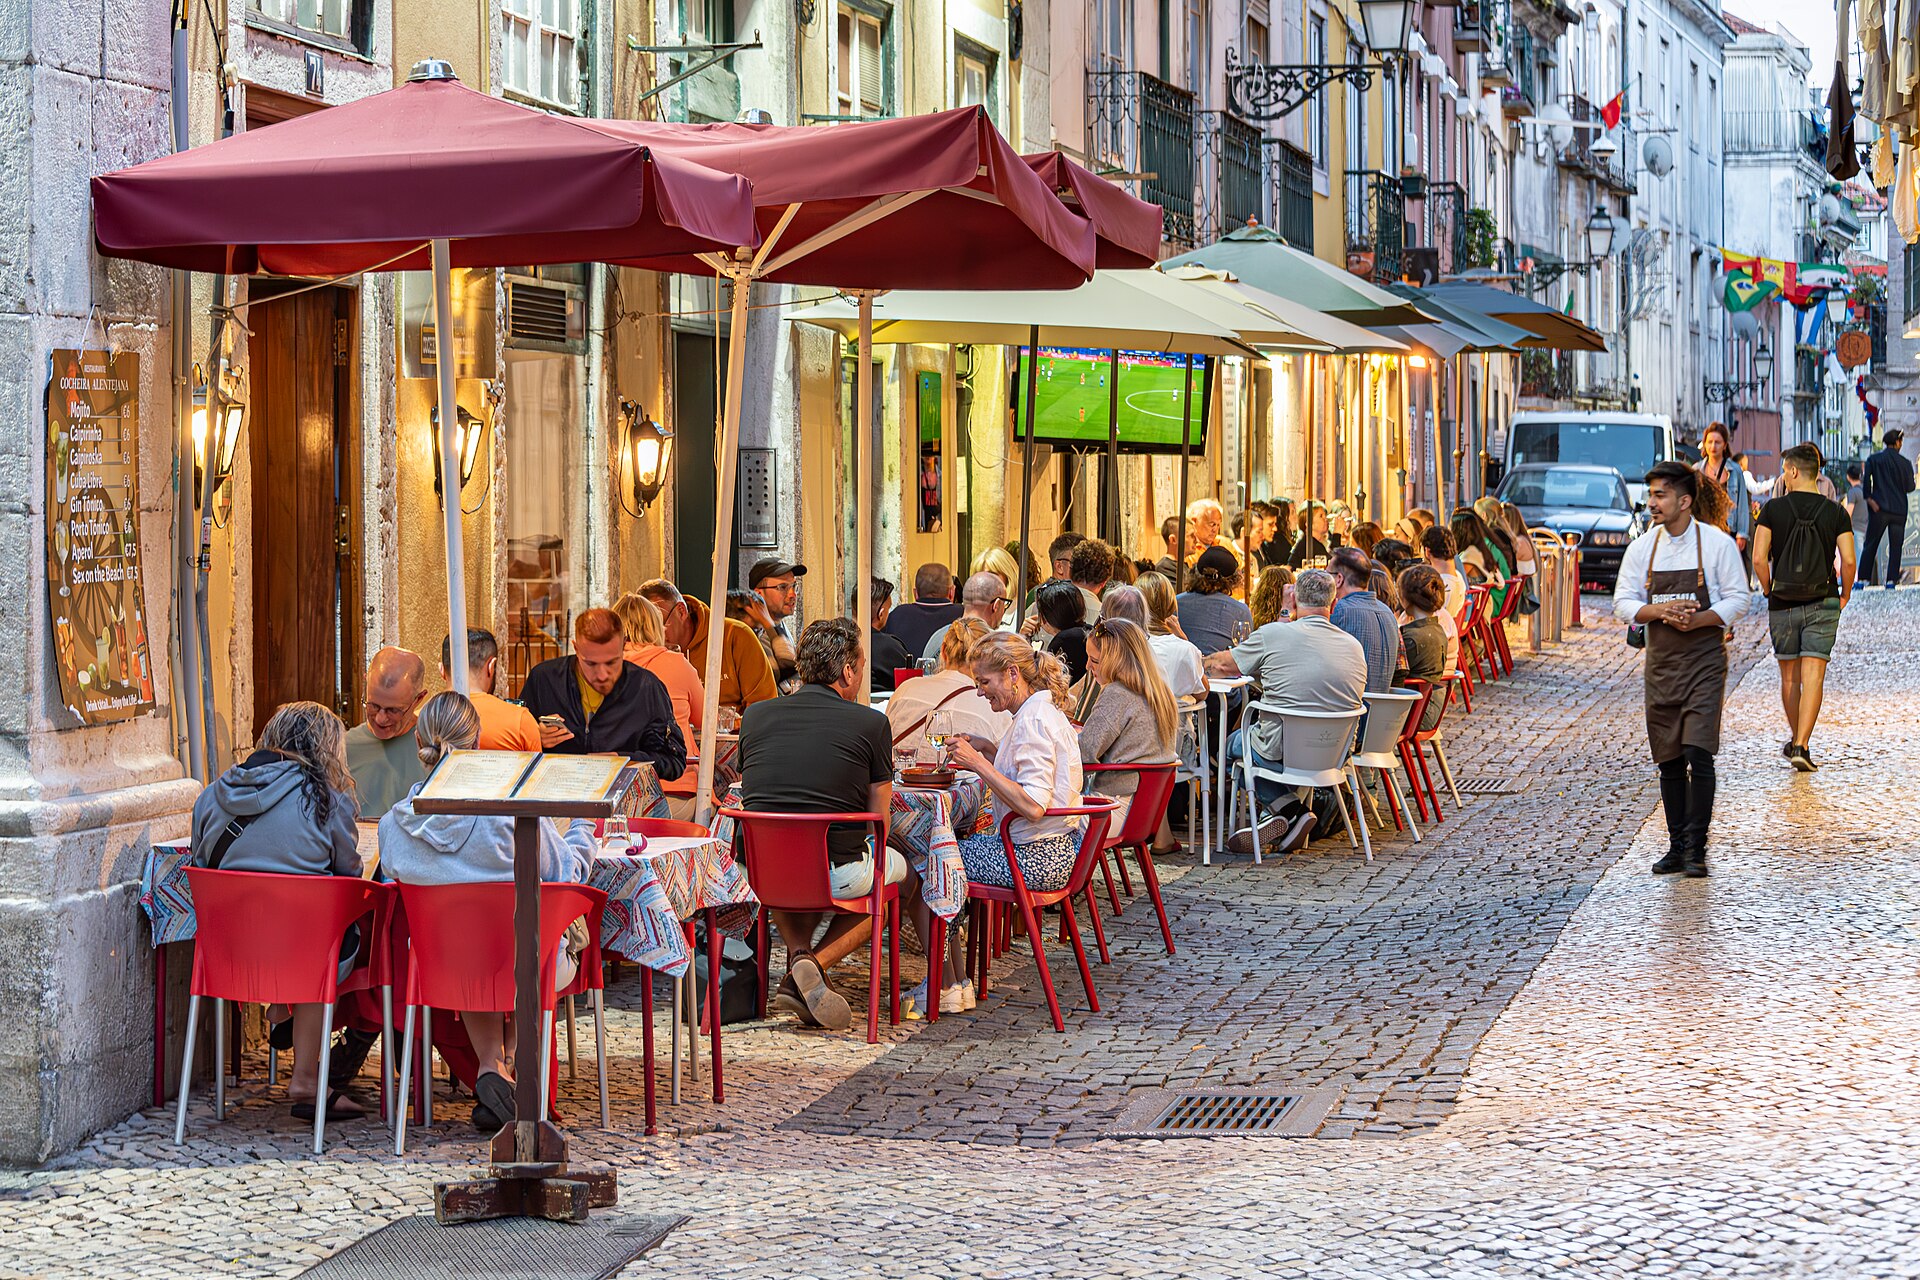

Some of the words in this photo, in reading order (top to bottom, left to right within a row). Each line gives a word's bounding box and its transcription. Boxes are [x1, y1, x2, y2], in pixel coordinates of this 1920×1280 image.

[60, 377, 90, 390] COCHEIRA
[92, 378, 129, 394] ALENTEJANA
[70, 401, 91, 422] Mojito
[123, 406, 131, 418] €6
[70, 424, 102, 446] Caipirinha
[123, 429, 131, 441] €6
[70, 448, 103, 470] Caipiroska
[123, 452, 131, 464] €6
[70, 473, 87, 489] Cuba
[87, 474, 103, 489] Libre
[124, 475, 131, 488] €6
[70, 496, 82, 513] Gin
[83, 495, 103, 512] Tónico
[124, 498, 131, 511] €6
[71, 520, 88, 537] Porto
[89, 518, 110, 535] Tónico
[124, 520, 132, 534] €6
[72, 542, 94, 562] Aperol
[125, 543, 137, 559] €7,5
[73, 568, 85, 584] Sex
[85, 571, 94, 584] on
[94, 566, 106, 583] the
[106, 563, 124, 583] Beach
[126, 566, 138, 582] €7,5
[86, 700, 98, 712] Drink
[112, 697, 122, 710] Enjoy
